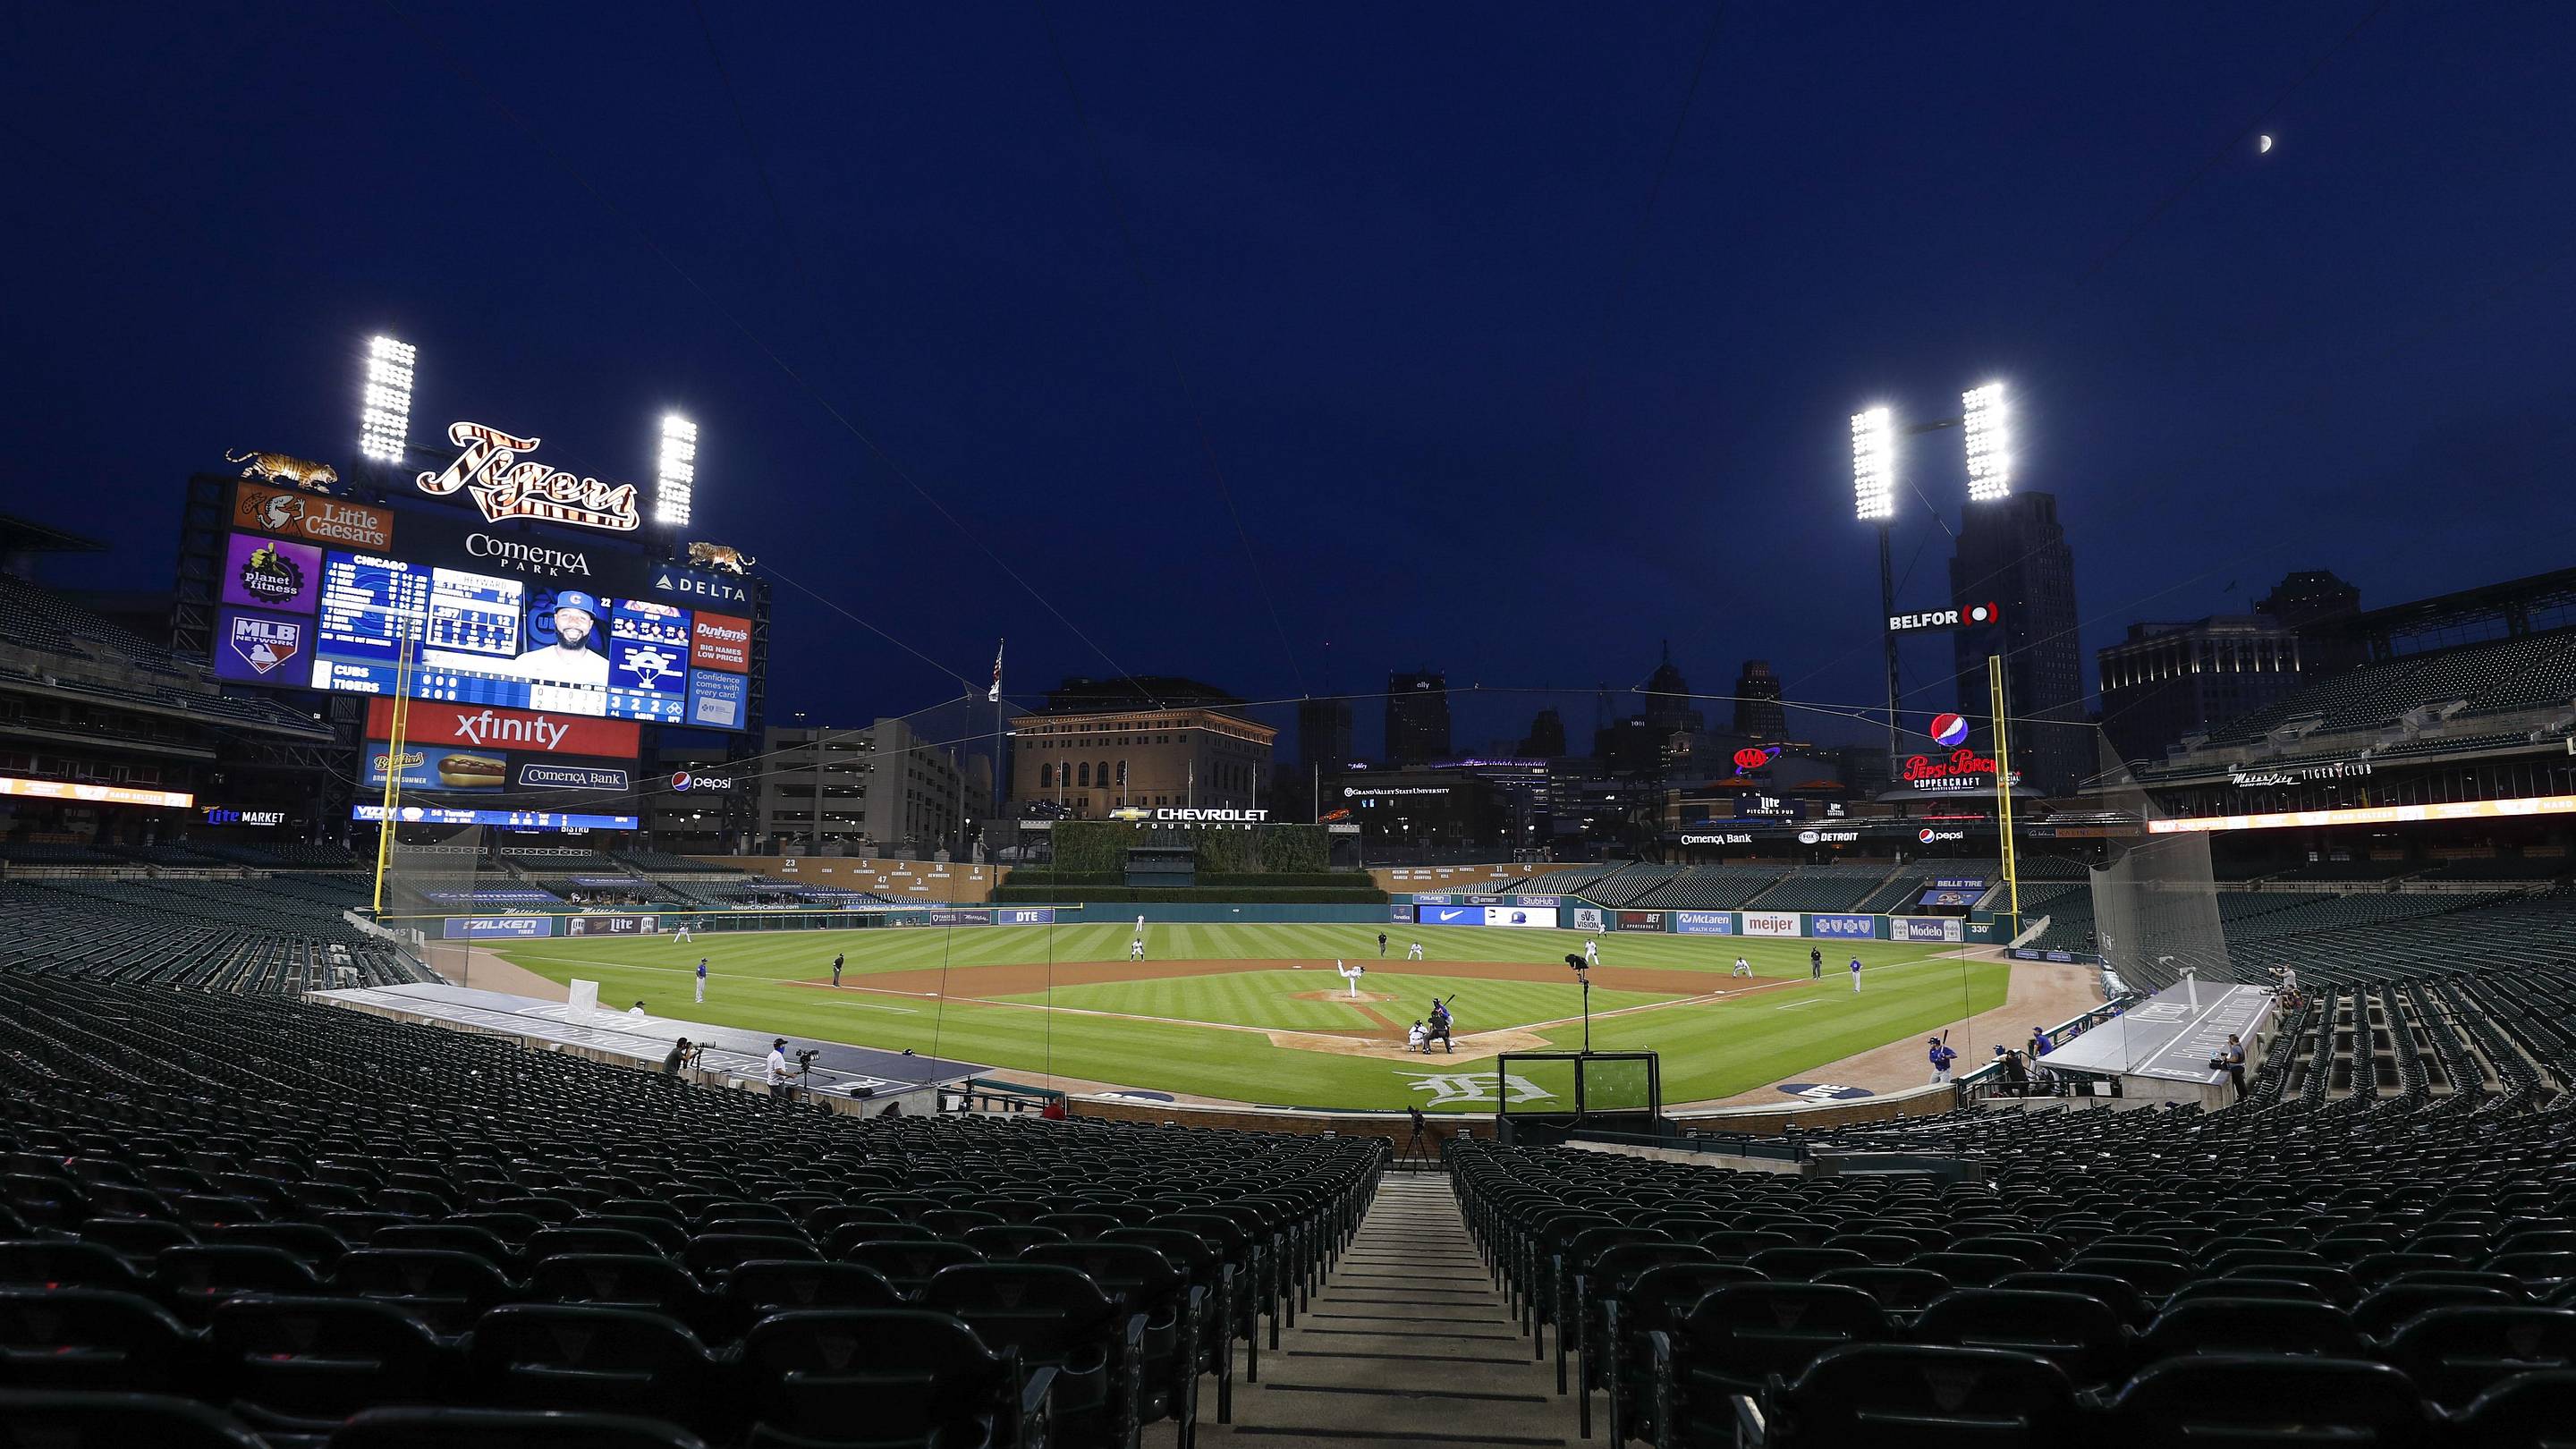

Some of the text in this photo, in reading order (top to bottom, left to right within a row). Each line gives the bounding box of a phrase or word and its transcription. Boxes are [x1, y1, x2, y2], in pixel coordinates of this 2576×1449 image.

[416, 421, 640, 530] Tigers
[323, 504, 378, 530] Little
[305, 516, 385, 546] Caesars
[353, 555, 408, 572] CHICAGO
[501, 559, 558, 577] PARK
[245, 572, 290, 586] planet
[464, 576, 507, 589] HEYWARD
[250, 580, 298, 595] fitness
[680, 578, 746, 602] DELTA
[600, 597, 611, 607] 22
[470, 611, 511, 626] 2 12
[1889, 610, 1958, 631] BELFOR
[236, 620, 295, 640] MLB
[697, 623, 748, 640] Dunham's
[235, 634, 294, 647] NETWORK
[700, 644, 741, 656] BIG NAMES
[716, 654, 743, 663] PRICES
[334, 665, 369, 678] CUBS
[422, 674, 431, 684] 0
[435, 675, 444, 686] 0
[448, 677, 457, 688] 0
[697, 671, 740, 684] Confidence
[333, 678, 380, 693] TIGERS
[421, 687, 429, 698] 2
[434, 689, 443, 699] 0
[447, 690, 456, 700] 0
[696, 681, 740, 691] comes with
[695, 689, 716, 698] every
[611, 696, 660, 712] 3 2 2
[453, 709, 570, 750] xfinity
[1738, 750, 1763, 764] AAA
[2301, 767, 2334, 780] TIGER
[2345, 764, 2371, 776] CLUB
[402, 776, 427, 784] SUMMER
[589, 773, 621, 785] Bank
[693, 777, 732, 791] pepsi
[1914, 777, 1980, 788] COPPERCRAFT
[1760, 797, 1780, 809] Lite
[208, 809, 240, 825] Lite
[242, 811, 285, 823] MARKET
[1157, 808, 1268, 821] CHEVROLET
[1726, 834, 1752, 843] Bank
[1820, 833, 1859, 842] DETROIT
[1936, 830, 1963, 841] pepsi
[899, 862, 904, 870] 2
[1523, 864, 1532, 872] 42
[1523, 897, 1554, 905] StubHub
[1016, 911, 1038, 922] DTE
[1692, 914, 1729, 925] McLaren
[463, 919, 537, 930] FALKEN
[610, 918, 634, 932] Lite
[1749, 916, 1793, 933] meijer
[1910, 925, 1942, 936] Modelo
